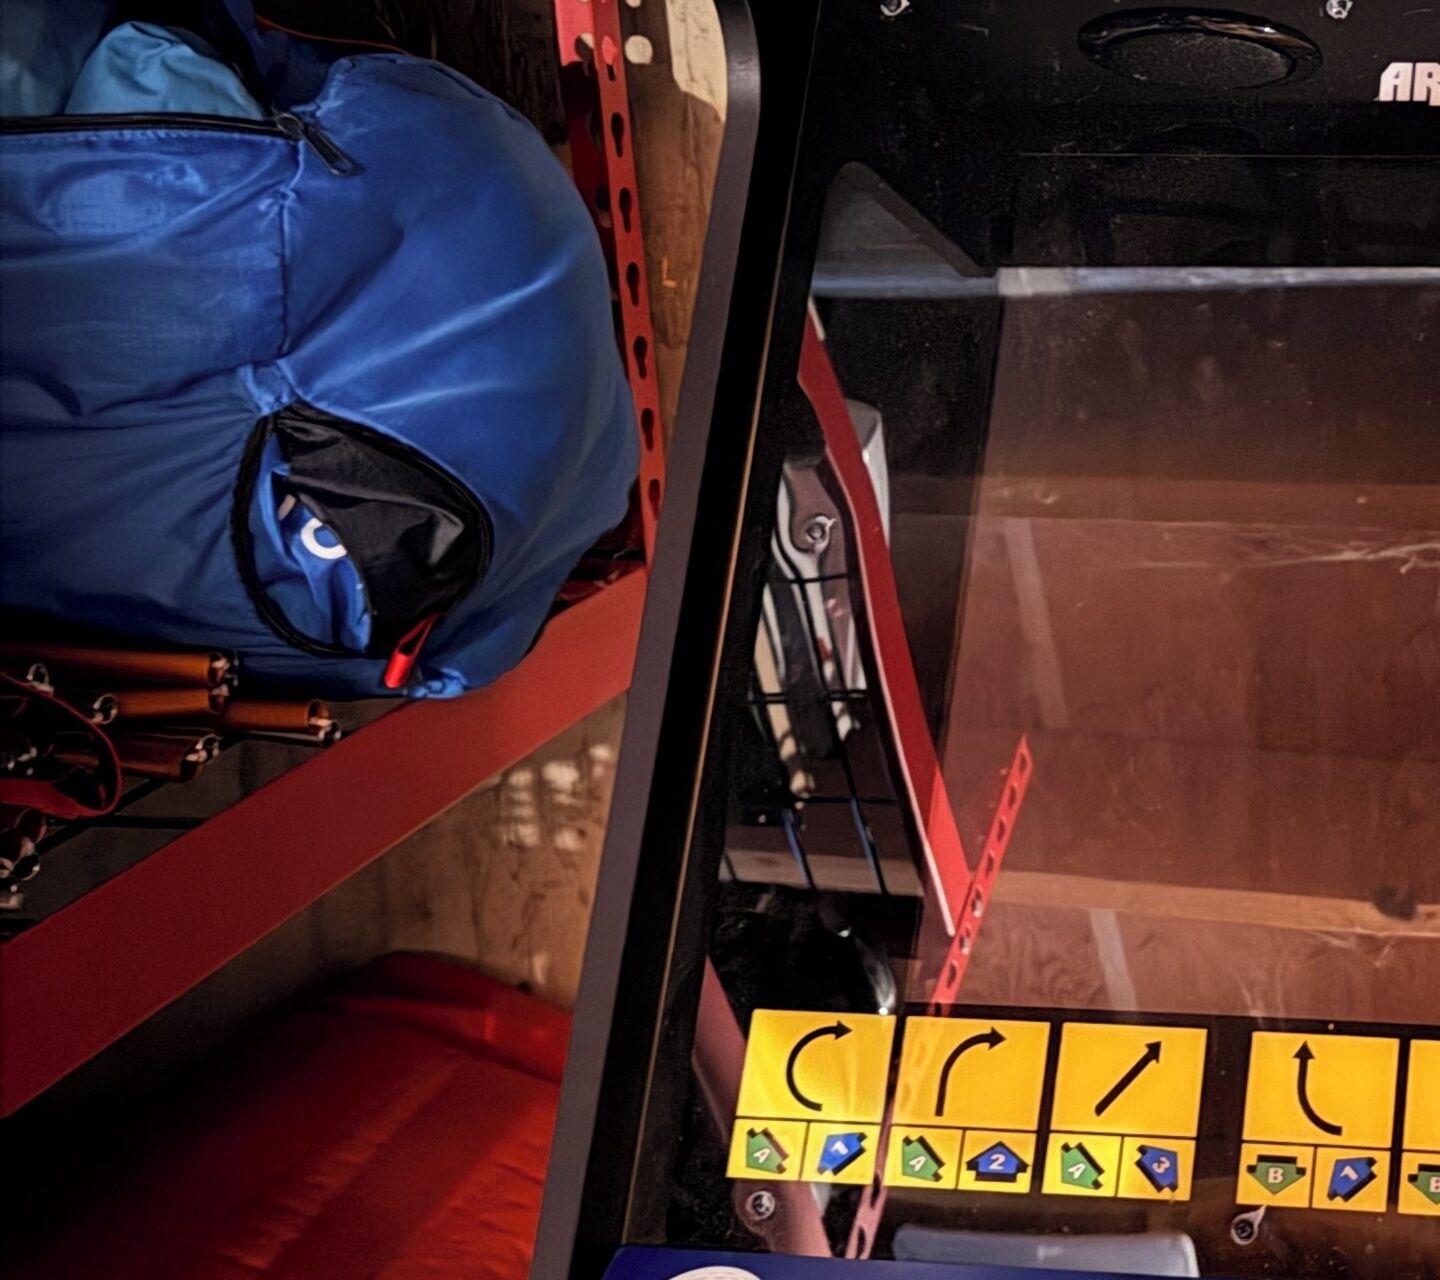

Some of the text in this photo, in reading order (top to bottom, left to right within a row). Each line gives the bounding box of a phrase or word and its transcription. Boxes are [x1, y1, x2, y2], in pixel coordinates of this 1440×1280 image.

[752, 1146, 772, 1166] A
[828, 1138, 848, 1157] 1
[909, 1154, 927, 1172] A
[989, 1153, 1007, 1171] 2
[1068, 1161, 1087, 1180] A
[1151, 1156, 1171, 1175] 3
[1267, 1167, 1285, 1184] B
[1339, 1166, 1359, 1182] 1
